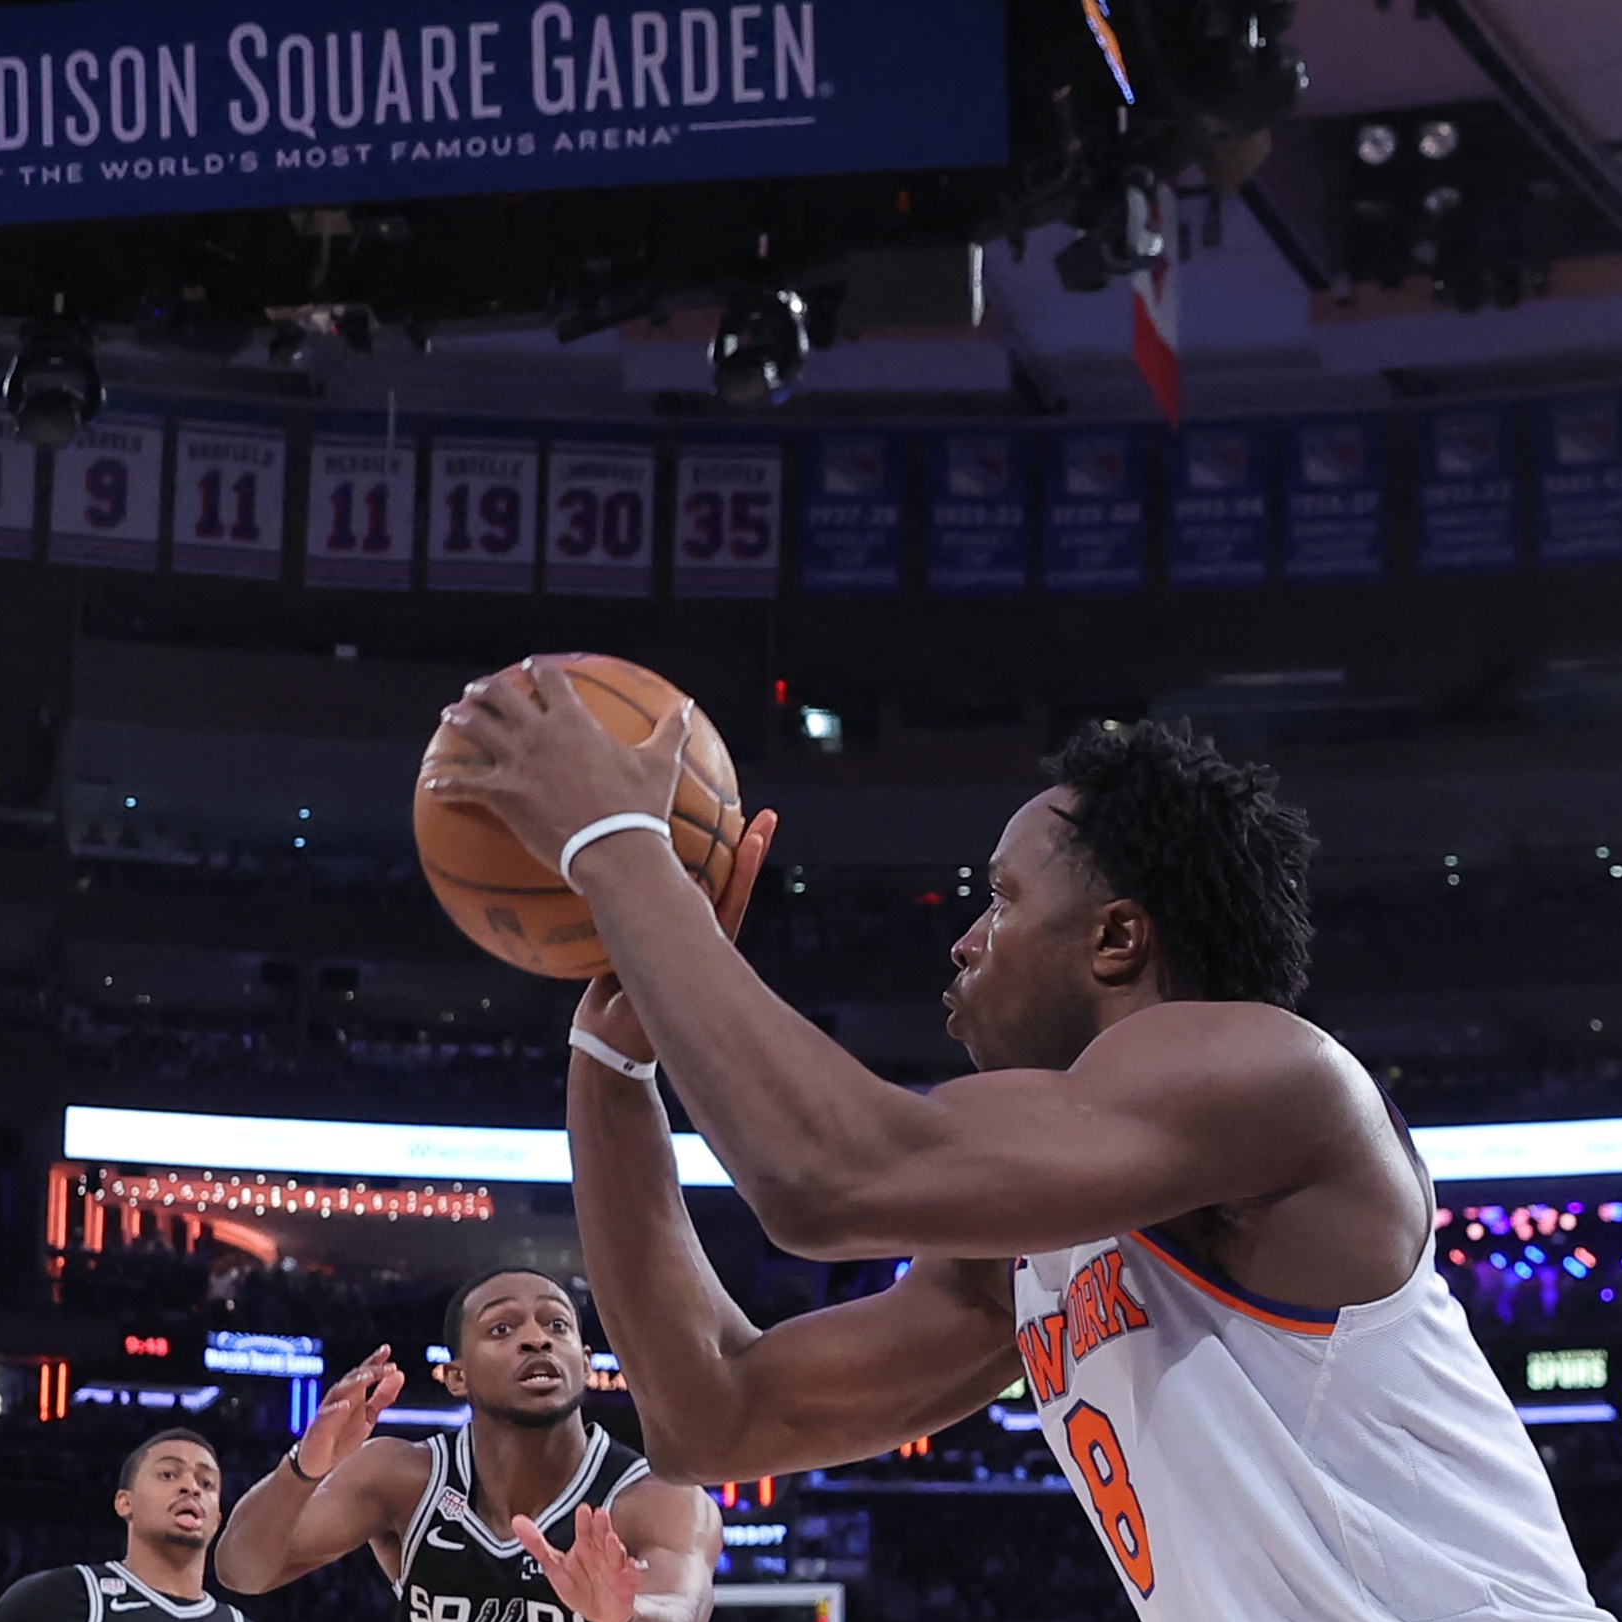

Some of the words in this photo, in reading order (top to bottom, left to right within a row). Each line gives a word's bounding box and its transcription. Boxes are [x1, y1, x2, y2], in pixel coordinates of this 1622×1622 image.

[227, 22, 503, 139] SQUARE
[531, 1, 816, 116] GARDEN
[19, 162, 84, 186] THE
[100, 151, 259, 181] WORLD'S
[276, 142, 373, 169] MOST
[391, 132, 536, 162] FAMOUS
[553, 125, 673, 154] ARENA
[85, 458, 129, 529] 9
[195, 467, 260, 541] 11
[328, 481, 392, 553] 11
[444, 483, 521, 555] 19
[558, 488, 644, 558] 30
[683, 490, 771, 560] 35
[1067, 1250, 1151, 1363] ORK
[1527, 1358, 1607, 1390] SPURS
[1063, 1398, 1155, 1601] 8
